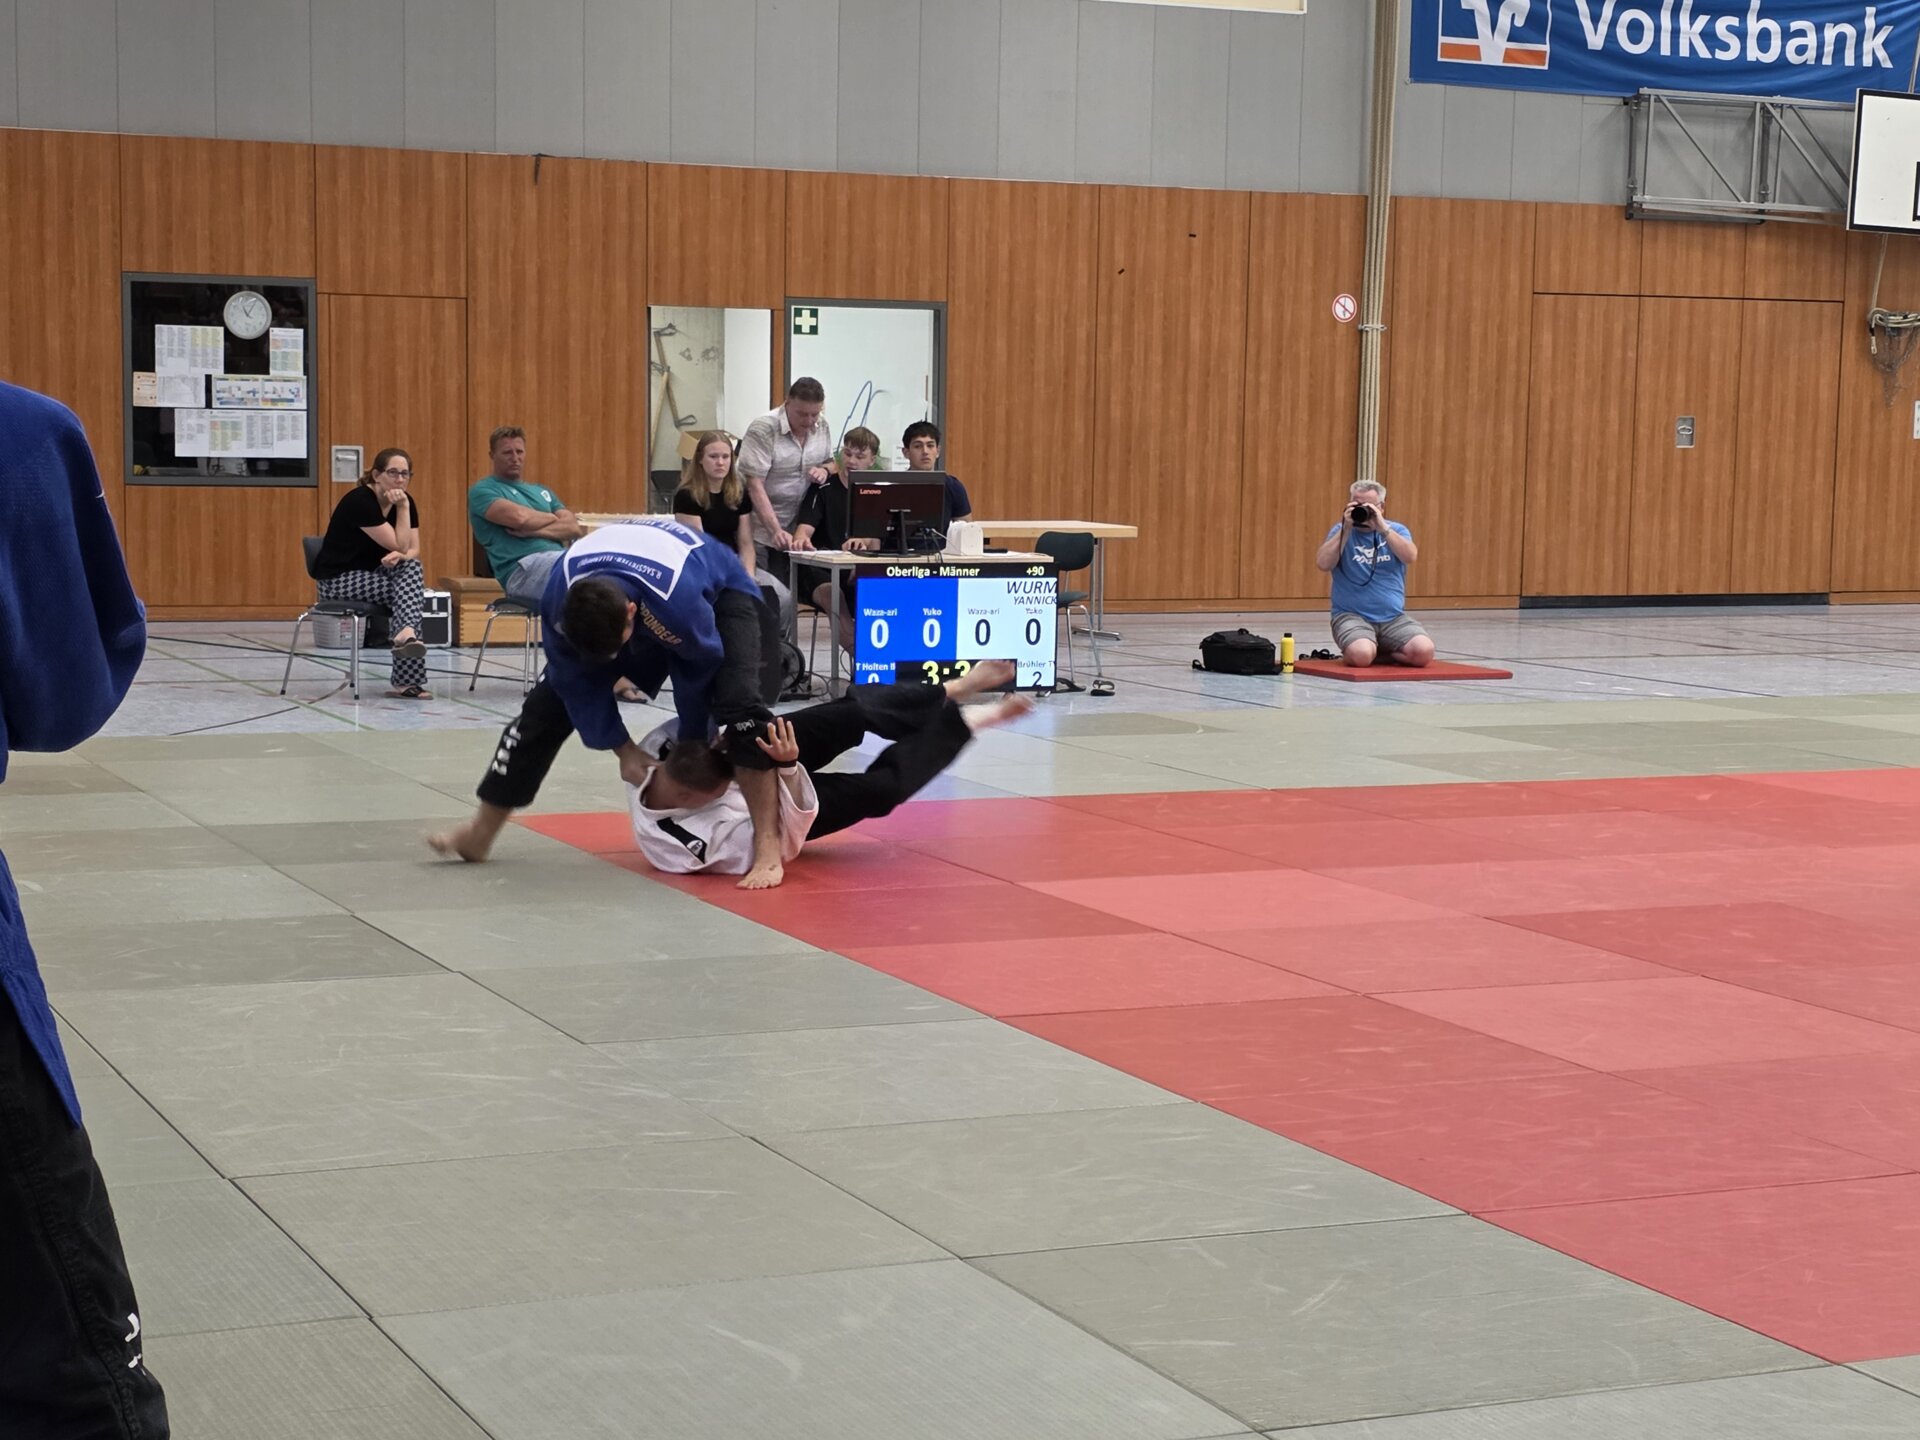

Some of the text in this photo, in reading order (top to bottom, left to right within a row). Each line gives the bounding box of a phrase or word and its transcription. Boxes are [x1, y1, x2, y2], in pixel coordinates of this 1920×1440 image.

[1577, 0, 1895, 69] Volksbank
[886, 566, 930, 578] Oberliga
[939, 566, 980, 577] Männer
[1026, 566, 1045, 576] +90
[1007, 580, 1057, 594] WURM
[1014, 596, 1057, 605] YANNICK
[863, 607, 942, 617] Waza-ari Yuko
[1025, 607, 1043, 615] Yuko
[870, 618, 941, 649] 0 0
[975, 618, 1041, 646] 0 0
